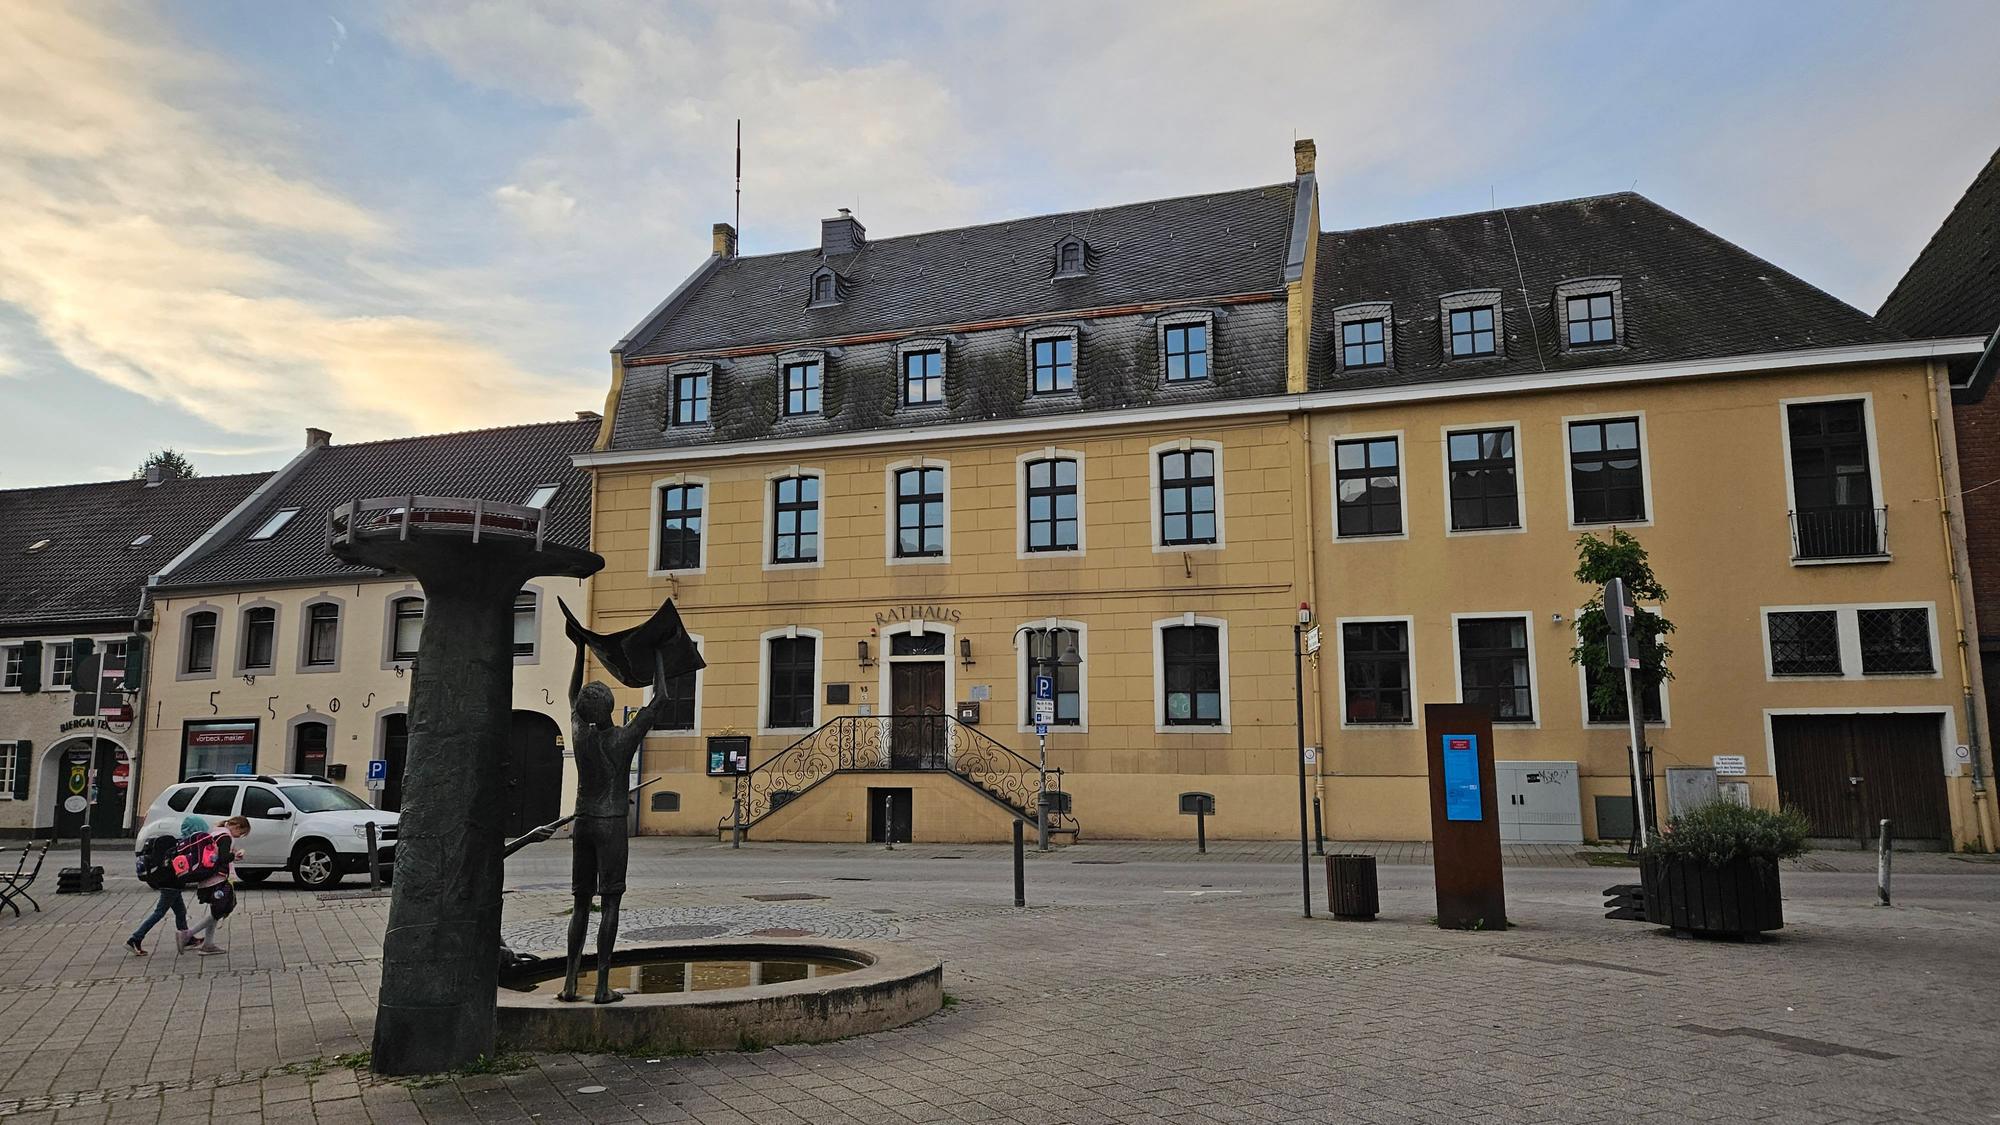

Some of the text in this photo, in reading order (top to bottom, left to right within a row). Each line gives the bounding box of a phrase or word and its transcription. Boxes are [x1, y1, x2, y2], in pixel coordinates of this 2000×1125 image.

[875, 605, 961, 625] RATHAUS
[1040, 679, 1049, 697] P
[61, 718, 108, 733] BIERGATE
[372, 763, 382, 777] P
